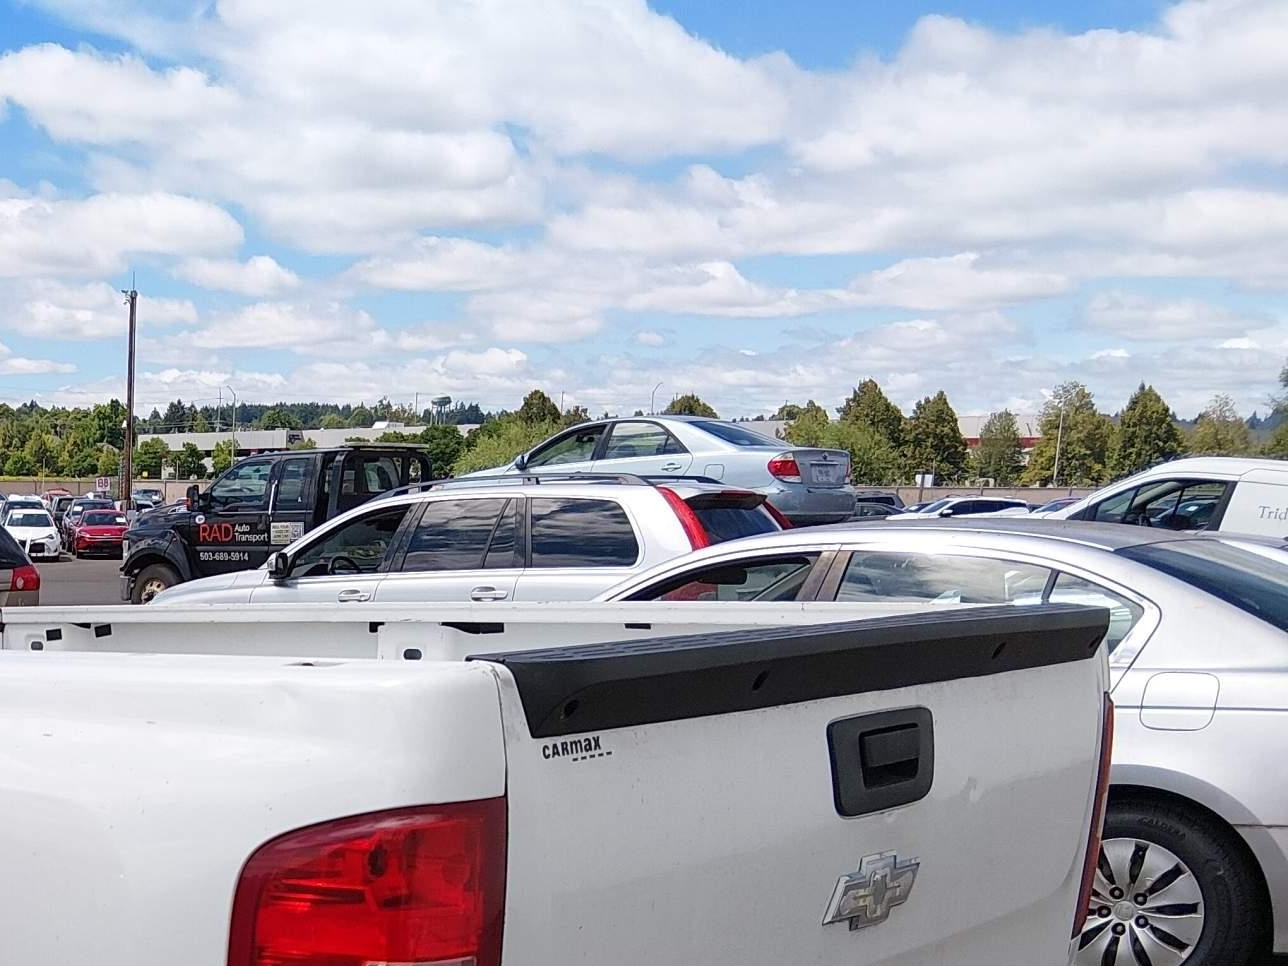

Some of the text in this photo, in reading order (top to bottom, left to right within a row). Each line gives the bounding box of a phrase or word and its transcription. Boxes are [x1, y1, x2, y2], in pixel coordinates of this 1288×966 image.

[199, 523, 233, 542] RAD
[234, 524, 250, 532] Auto
[234, 533, 268, 543] Transport
[199, 552, 249, 561] 503-689-5914
